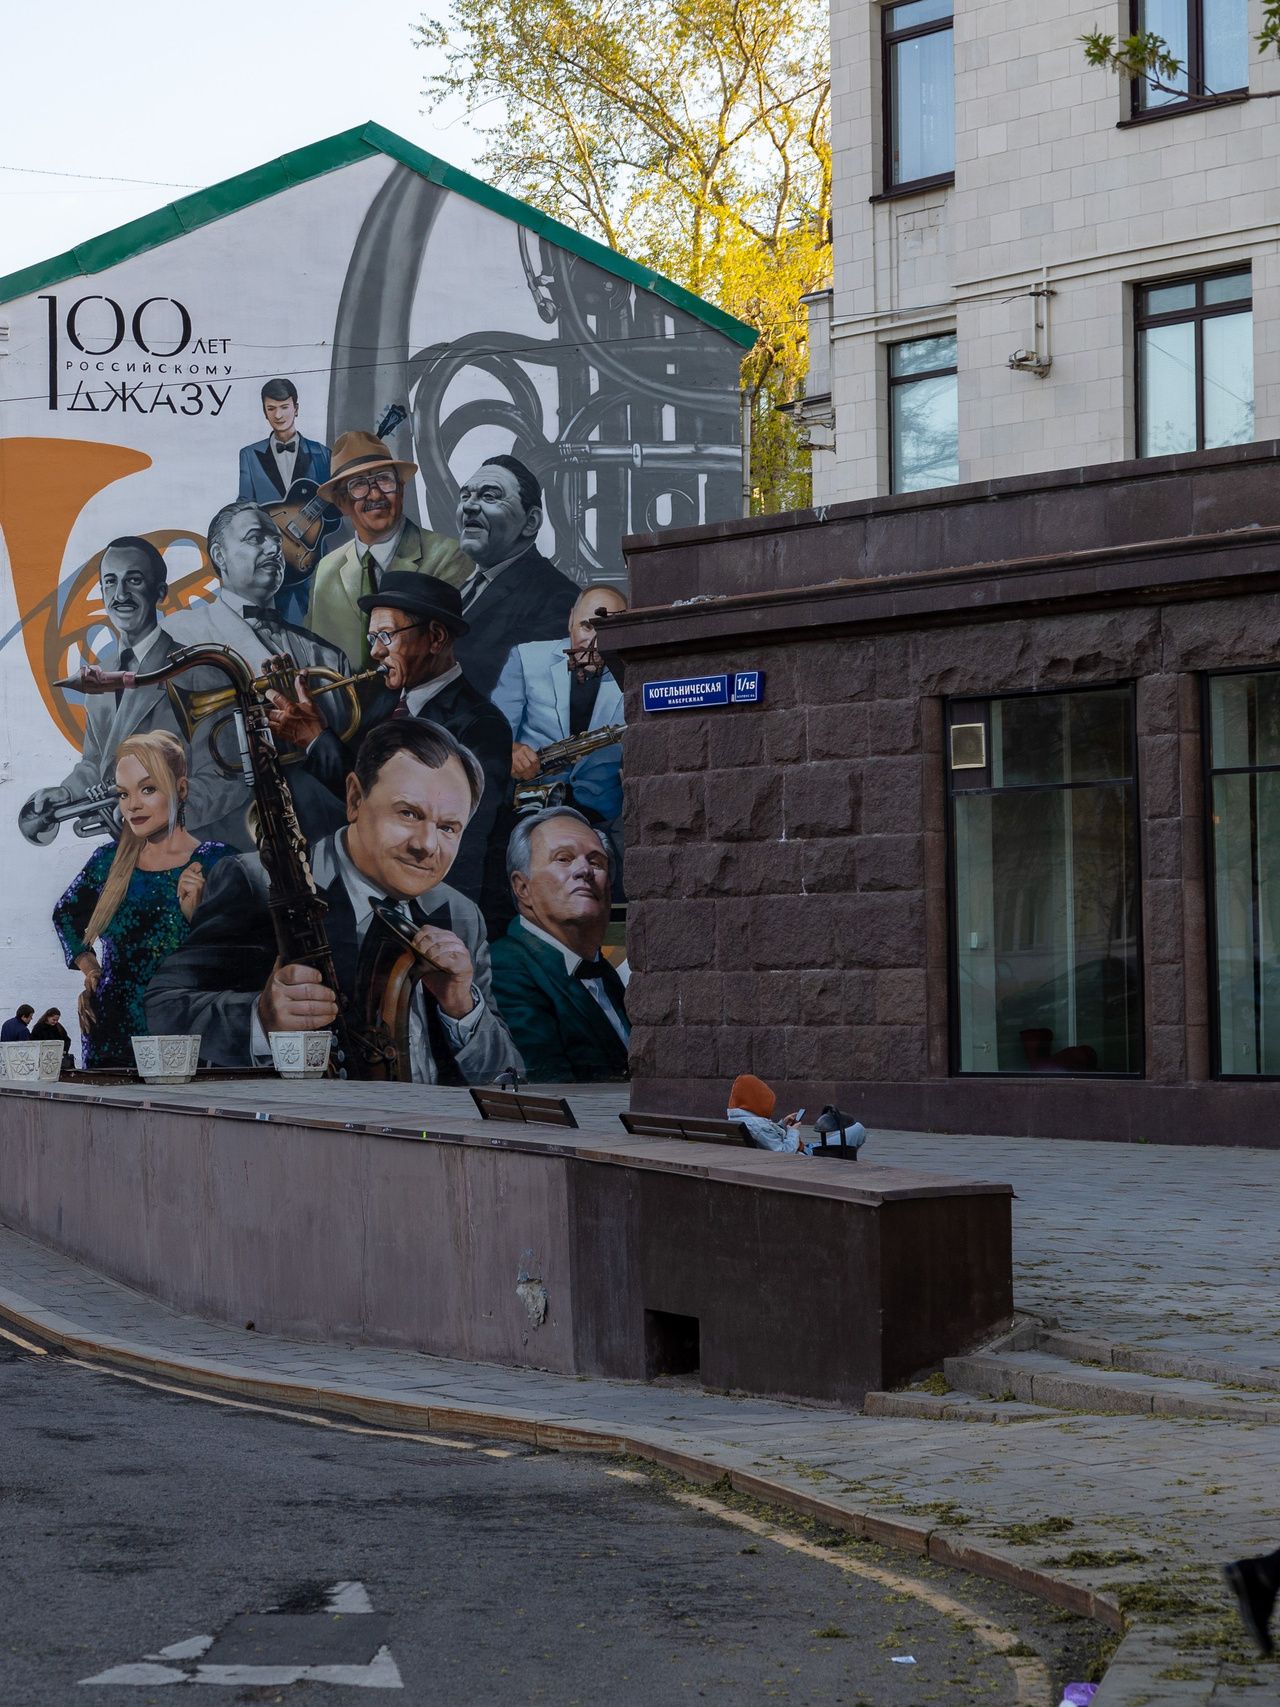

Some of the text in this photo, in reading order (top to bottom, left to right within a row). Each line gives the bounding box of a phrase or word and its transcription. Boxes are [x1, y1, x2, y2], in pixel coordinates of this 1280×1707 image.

[37, 295, 232, 410] 100 ЛЕТ
[66, 361, 232, 375] РОССИЙСКОМУ
[67, 380, 232, 416] ДЖАЗУ
[649, 682, 721, 699] КОТЕЛЬНИЧЕСКАЯ
[738, 677, 756, 692] 1/15
[668, 696, 704, 705] НАБЕРЕЖНАЯ
